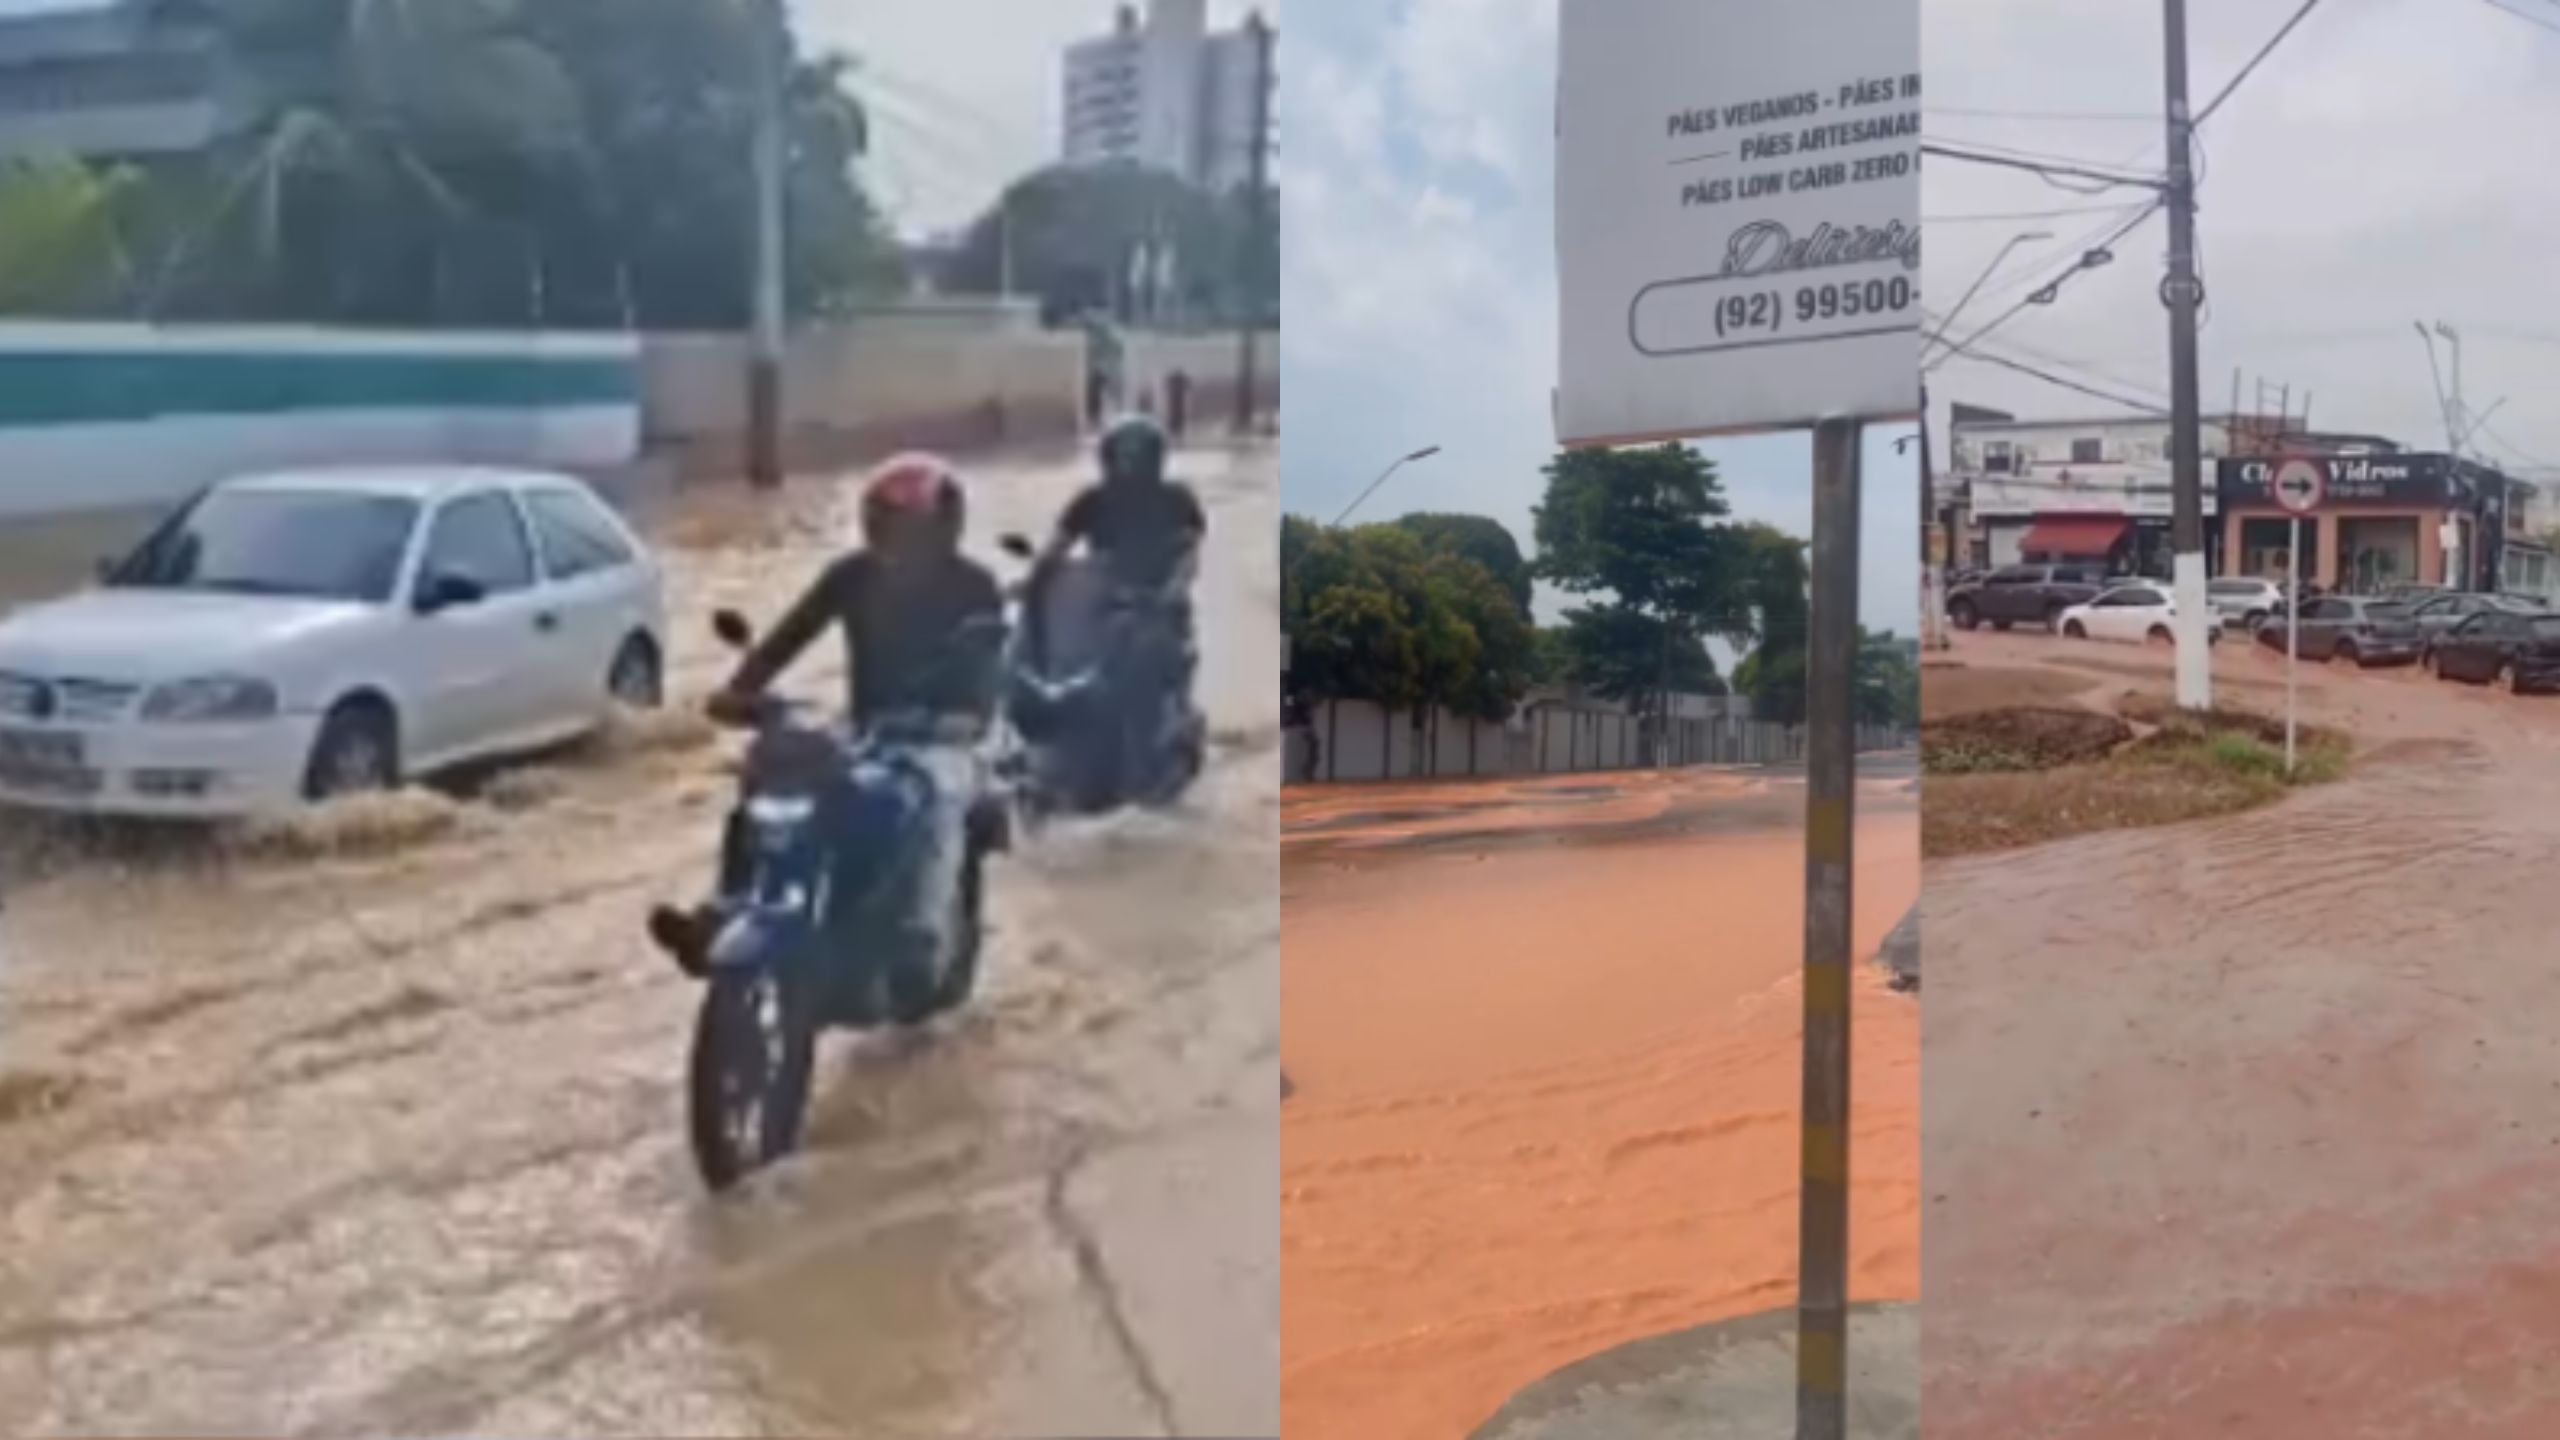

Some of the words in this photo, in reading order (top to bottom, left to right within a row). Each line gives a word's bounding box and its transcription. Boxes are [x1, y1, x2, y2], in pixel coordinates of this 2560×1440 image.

[1722, 91, 1819, 128] VEGANOS
[1799, 112, 1921, 152] ARTESANAI
[1738, 172, 1784, 199] LOW
[1788, 163, 1845, 191] CARB
[1852, 152, 1909, 183] ZERO
[1714, 290, 1782, 338] (92)
[1795, 276, 1920, 322] 99500-
[2328, 459, 2408, 481] Vidros
